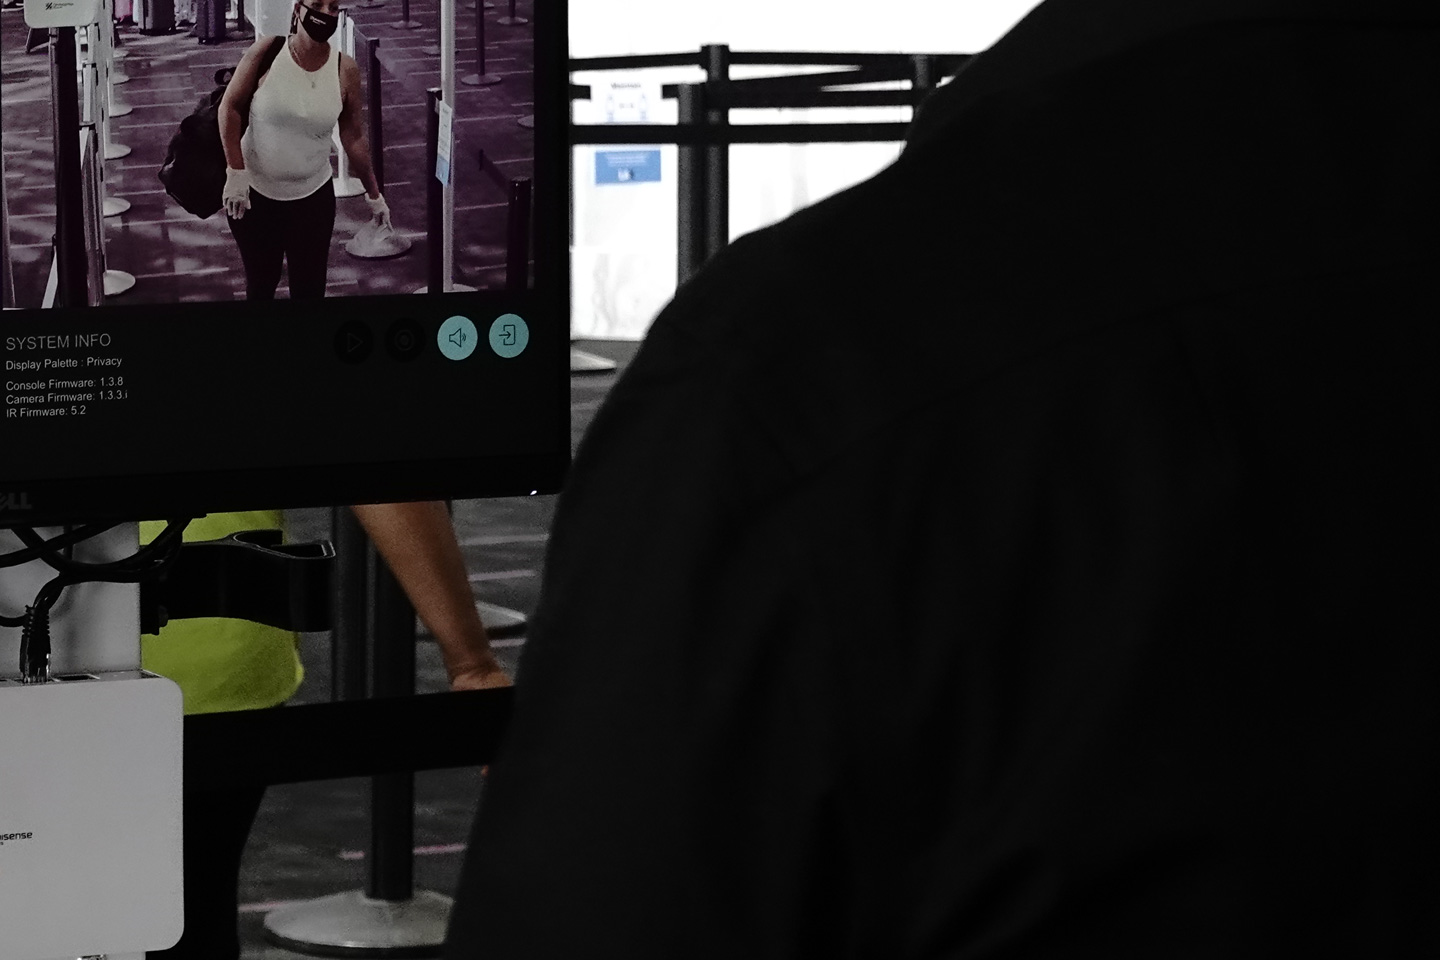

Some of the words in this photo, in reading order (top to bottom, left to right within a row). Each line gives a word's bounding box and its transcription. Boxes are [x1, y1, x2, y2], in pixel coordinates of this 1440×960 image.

[6, 335, 70, 351] SYSTEM
[75, 333, 111, 348] INFO
[5, 360, 42, 372] Display
[44, 358, 78, 369] Palette
[86, 356, 123, 368] Privacy
[5, 380, 46, 391] Console
[48, 378, 97, 390] Firmware:
[100, 376, 124, 387] 1.3.8
[5, 394, 45, 405] Camera
[47, 392, 96, 403] Firmware:
[6, 408, 17, 418] IR
[20, 406, 68, 417] Firmware:
[70, 405, 87, 416] 5.2
